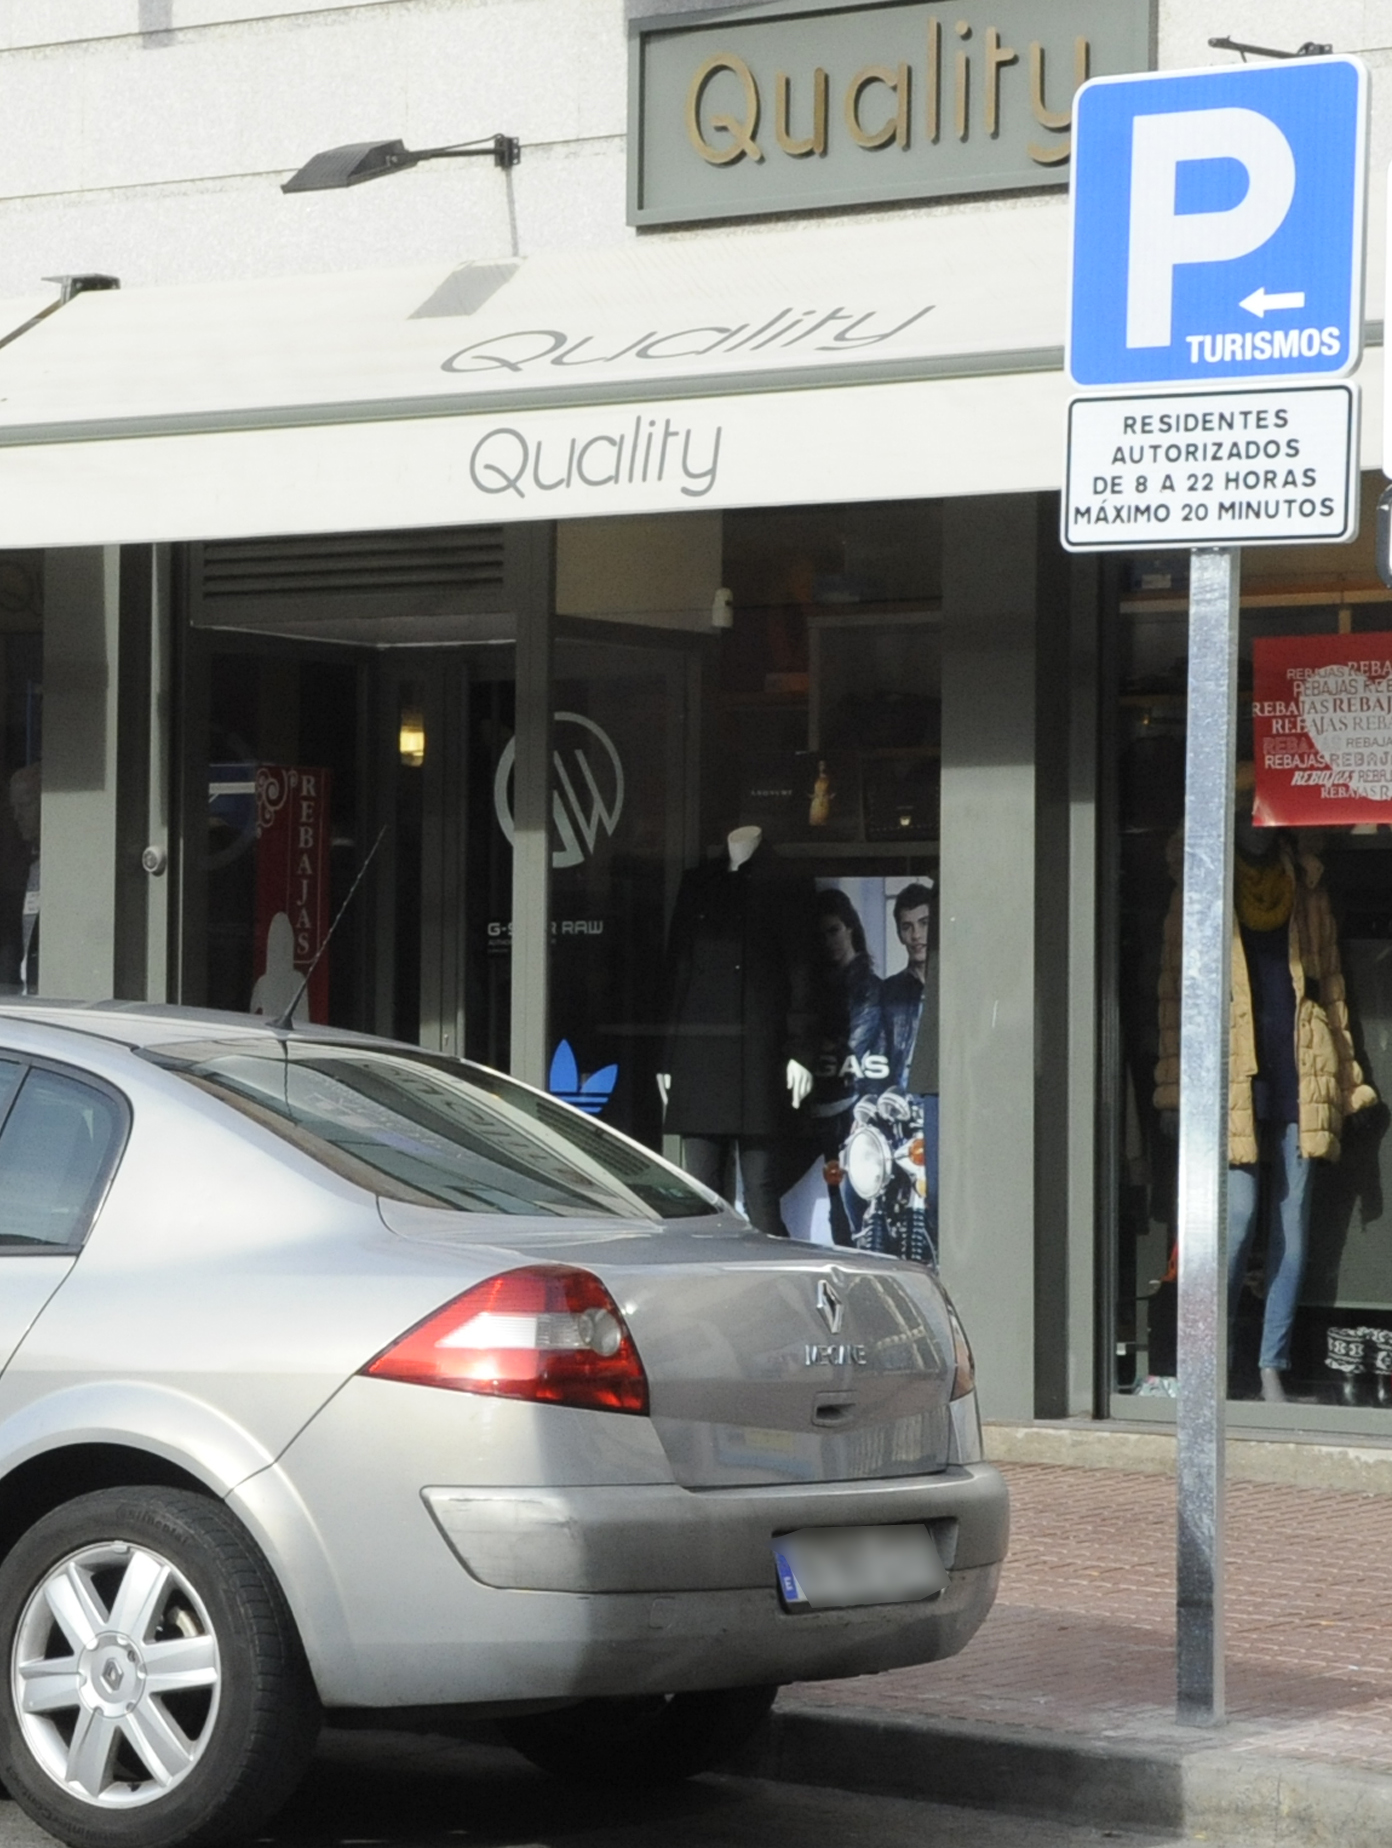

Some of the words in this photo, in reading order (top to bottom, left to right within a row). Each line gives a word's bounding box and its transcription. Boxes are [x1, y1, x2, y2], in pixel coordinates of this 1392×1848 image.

[687, 17, 1090, 165] Quality
[1126, 107, 1296, 349] P
[440, 305, 936, 373] Quality
[1185, 327, 1341, 364] TURISMOS
[1123, 408, 1289, 435] RESIDENTES
[469, 415, 723, 498] Quality
[1111, 438, 1301, 465] AUTORIZADOS
[1092, 475, 1123, 495] DE
[1134, 475, 1148, 493] 8
[1160, 474, 1175, 493] A
[1186, 473, 1214, 491] 22
[1224, 468, 1317, 490] HORAS
[1073, 499, 1170, 525] MÁXIMO
[1181, 503, 1209, 522] 20
[1217, 497, 1335, 521] MINUTOS
[1286, 667, 1345, 680] REBAJAS
[1293, 679, 1358, 698] REBAJAS
[1250, 700, 1329, 718] REBAJAS
[1272, 715, 1348, 736] REBAJAS
[1264, 753, 1325, 769] REBAJAS
[296, 774, 316, 954] REBAJAS
[561, 920, 604, 935] RAW
[815, 1054, 891, 1080] GAS
